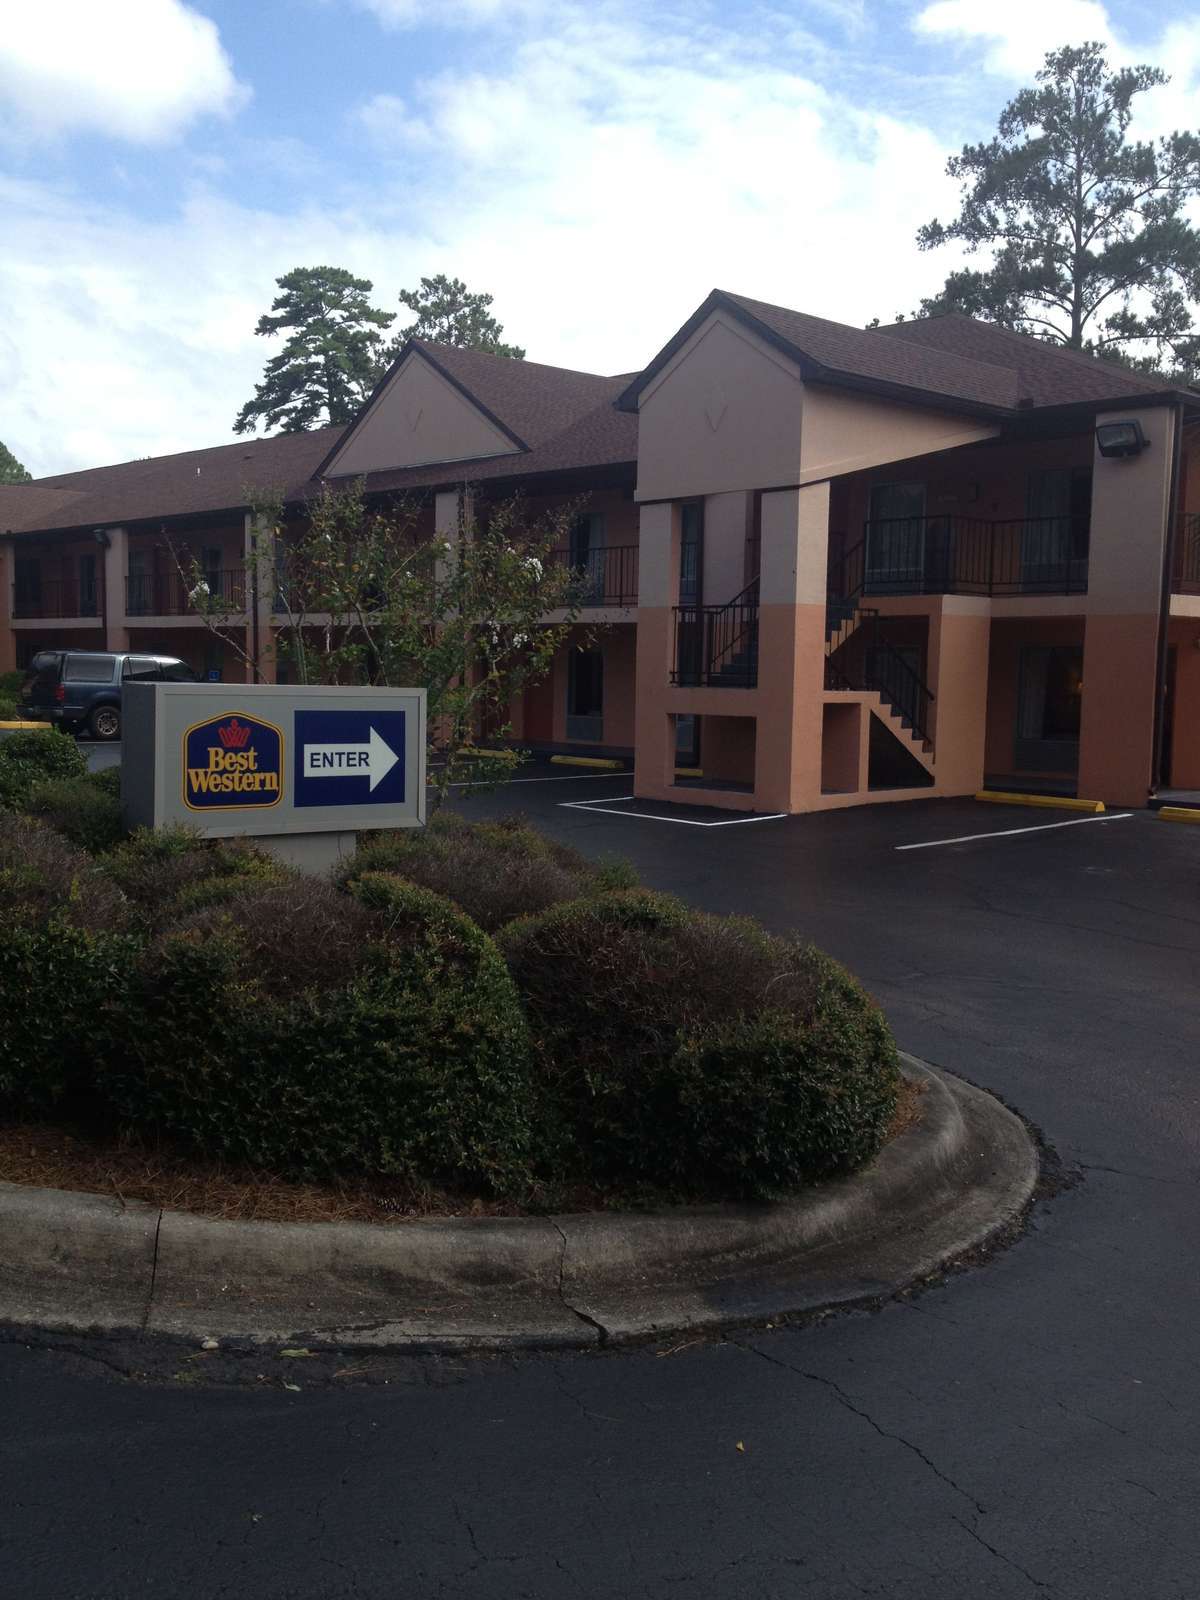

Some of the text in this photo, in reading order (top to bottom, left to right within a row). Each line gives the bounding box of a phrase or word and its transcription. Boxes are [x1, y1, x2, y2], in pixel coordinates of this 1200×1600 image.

[208, 747, 258, 771] Best
[310, 752, 370, 768] ENTER
[187, 768, 279, 793] Western
